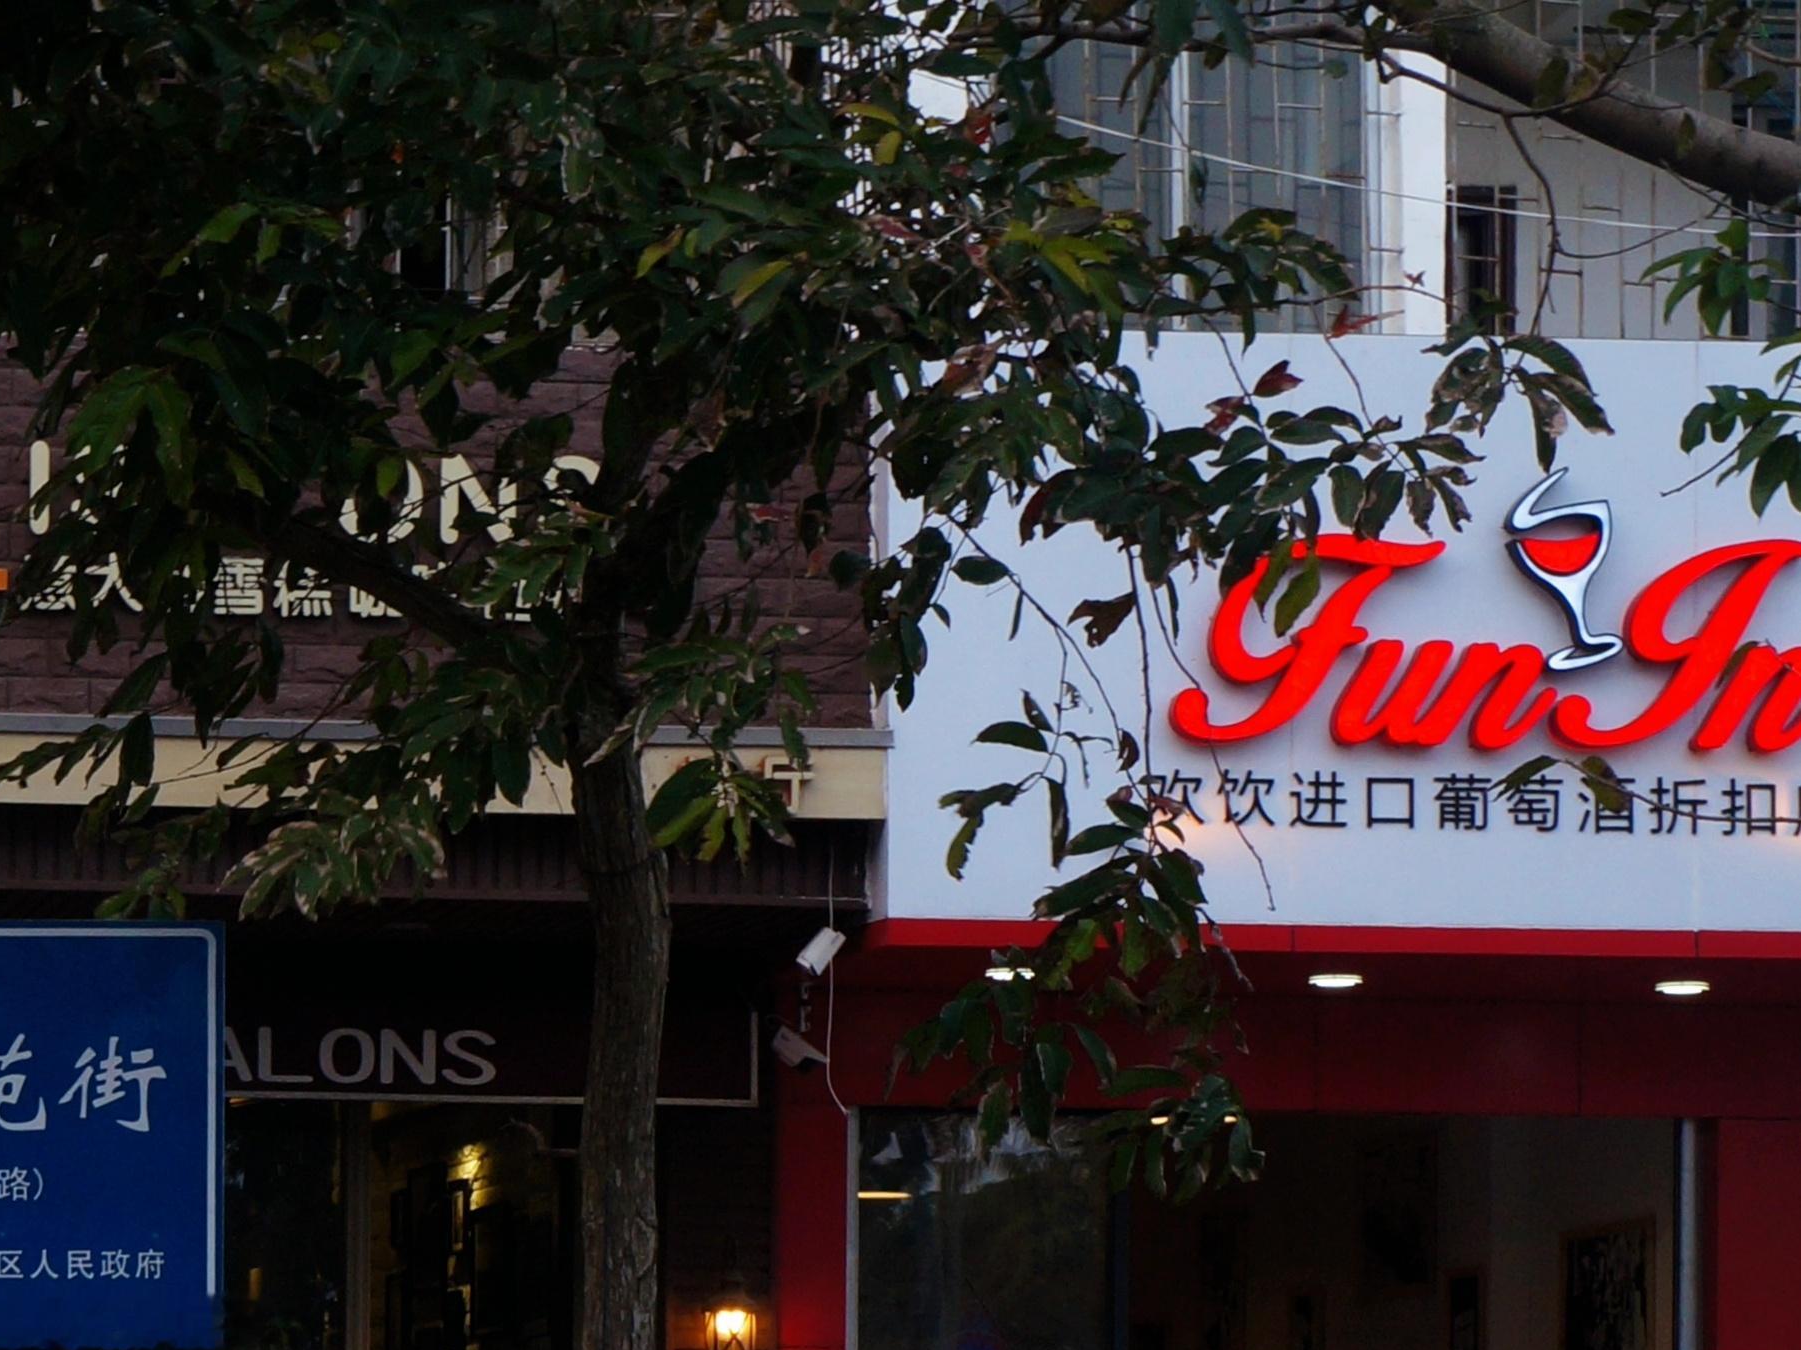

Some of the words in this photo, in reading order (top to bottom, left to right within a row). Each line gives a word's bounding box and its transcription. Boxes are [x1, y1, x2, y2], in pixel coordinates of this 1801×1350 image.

[1168, 533, 1558, 748] Fun
[1148, 769, 1801, 836] 欢饮进口葡萄酒折扣
